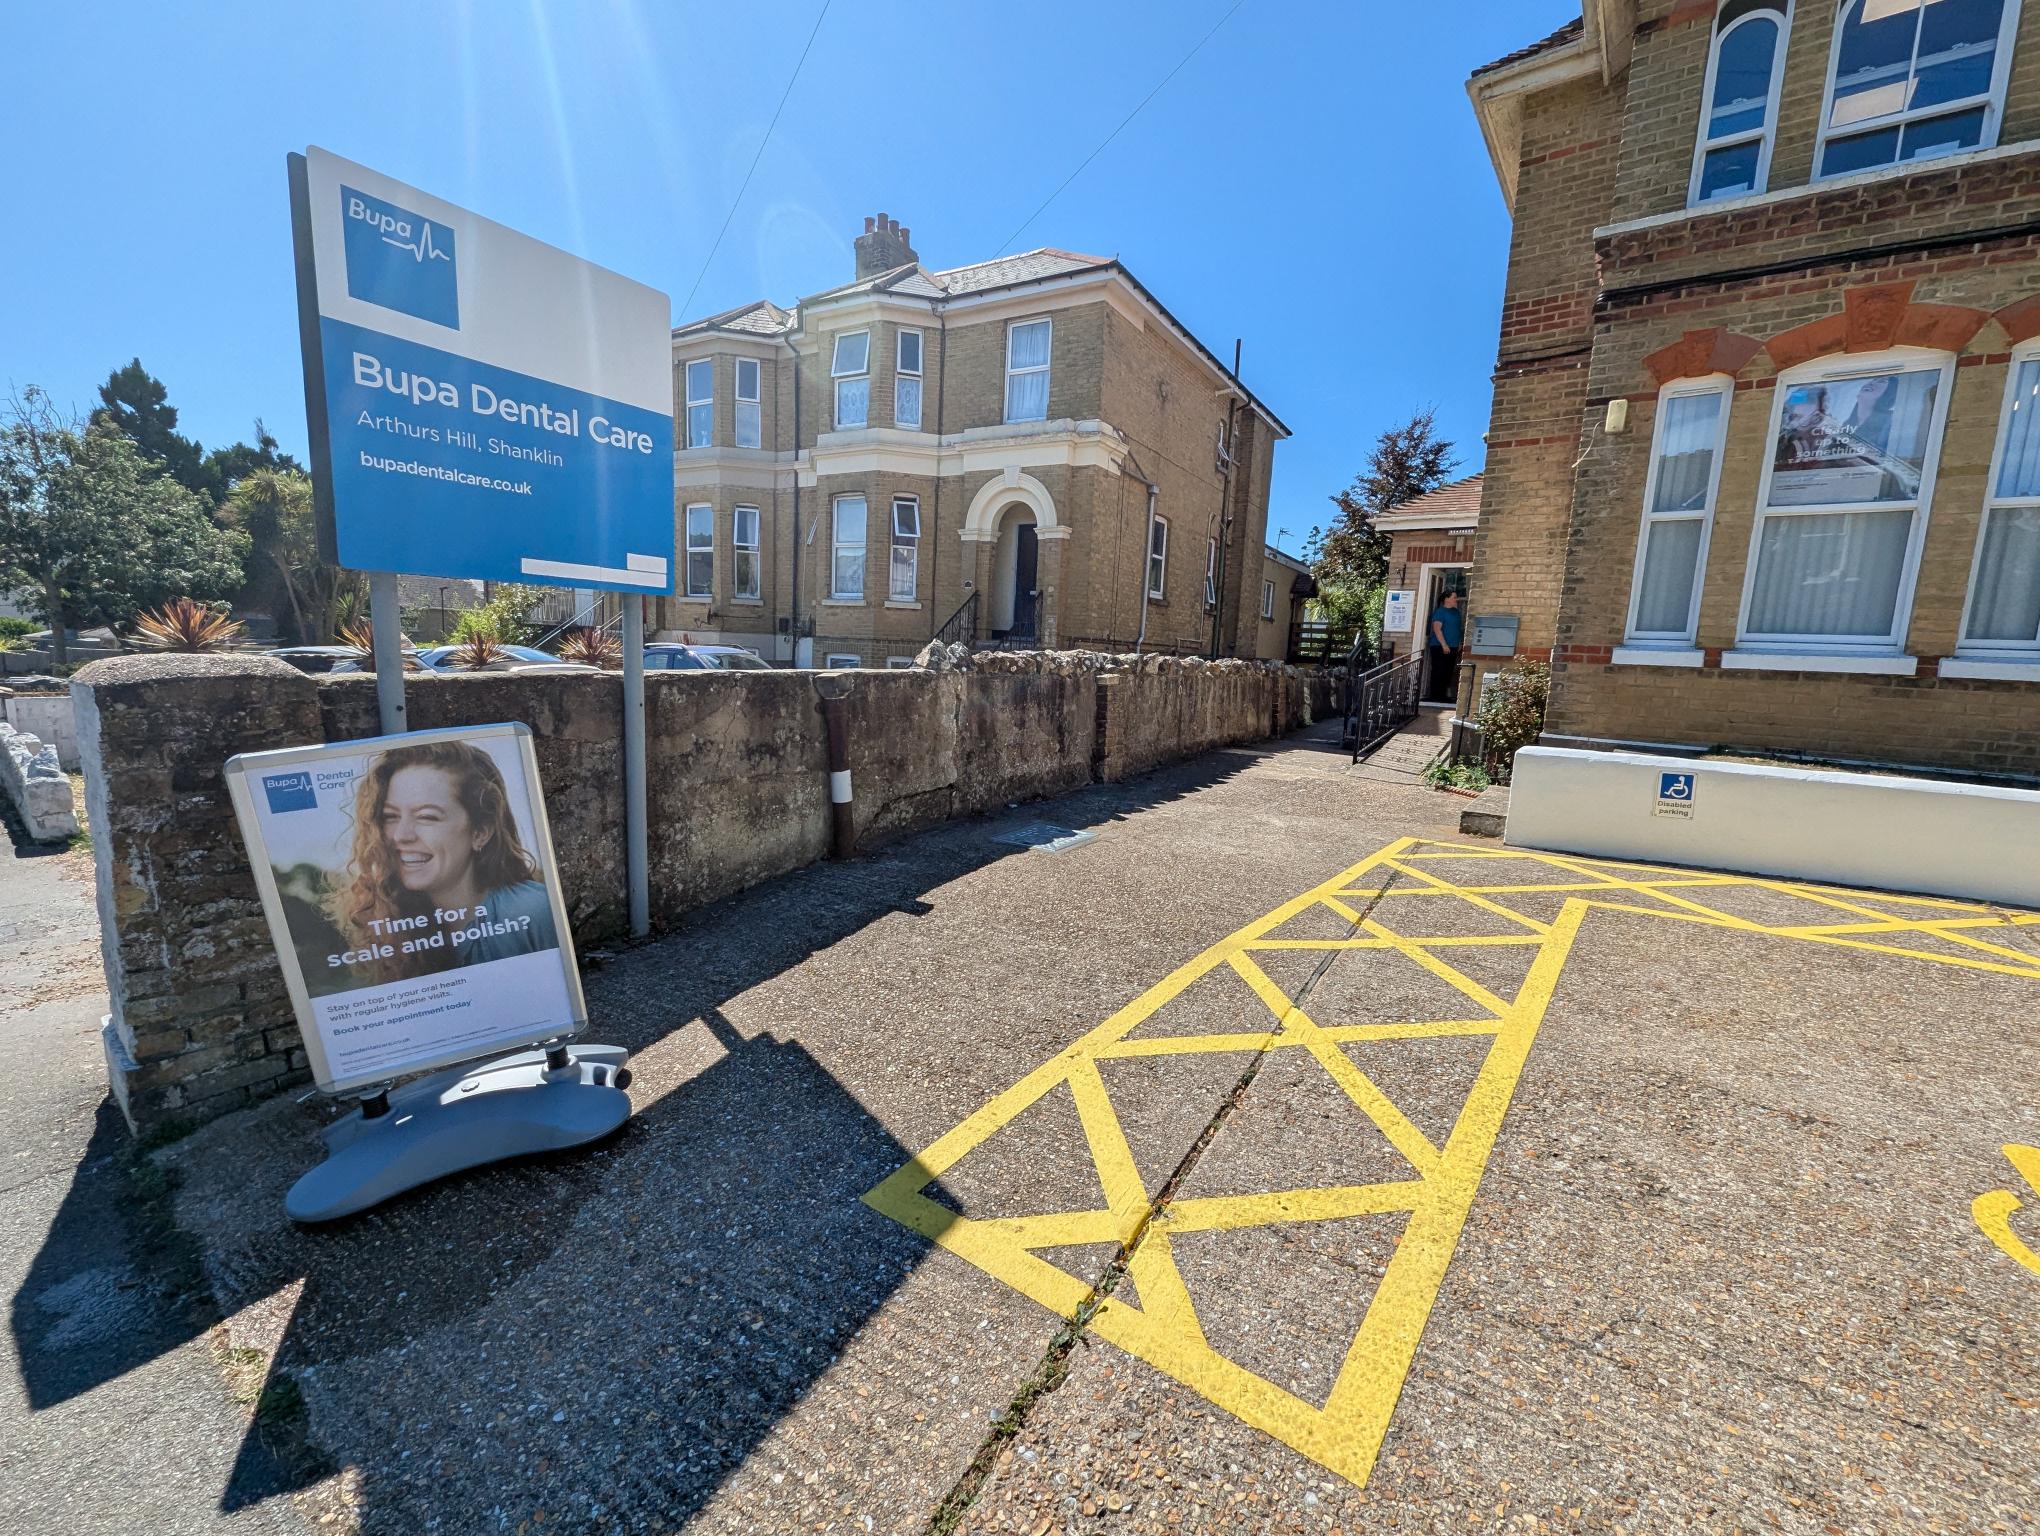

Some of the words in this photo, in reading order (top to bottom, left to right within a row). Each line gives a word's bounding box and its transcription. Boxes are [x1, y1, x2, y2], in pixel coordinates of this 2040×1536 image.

[349, 197, 411, 238] Bupa
[353, 352, 459, 408] Bupa
[471, 384, 579, 437] Dental
[588, 416, 653, 454] Care
[357, 410, 440, 442] Arthurs
[447, 429, 481, 453] Hill,
[488, 438, 563, 467] Shanklin
[1811, 425, 1858, 436] Clearly
[1796, 446, 1866, 458] something
[360, 451, 533, 495] bupadentalcare.co.uk
[267, 778, 298, 788] Bupa
[316, 769, 354, 782] Dental
[319, 781, 346, 790] Care
[1657, 801, 1692, 809] Disabled
[1658, 809, 1689, 817] parking
[368, 915, 429, 936] Time
[434, 907, 468, 924] for
[474, 905, 488, 917] a
[327, 943, 395, 967] scale
[401, 931, 444, 953] and
[451, 916, 531, 947] polish?
[327, 1003, 350, 1013] Stay
[353, 1000, 366, 1008] on
[368, 996, 385, 1006] top
[387, 992, 397, 1001] of
[398, 989, 420, 999] your
[421, 984, 438, 993] oral
[440, 977, 467, 989] health
[329, 1012, 352, 1022] with
[354, 1005, 389, 1017] regular
[390, 997, 427, 1009] hygiene
[333, 1025, 360, 1036] Book
[362, 1020, 385, 1031] your
[387, 1006, 445, 1025] appointment
